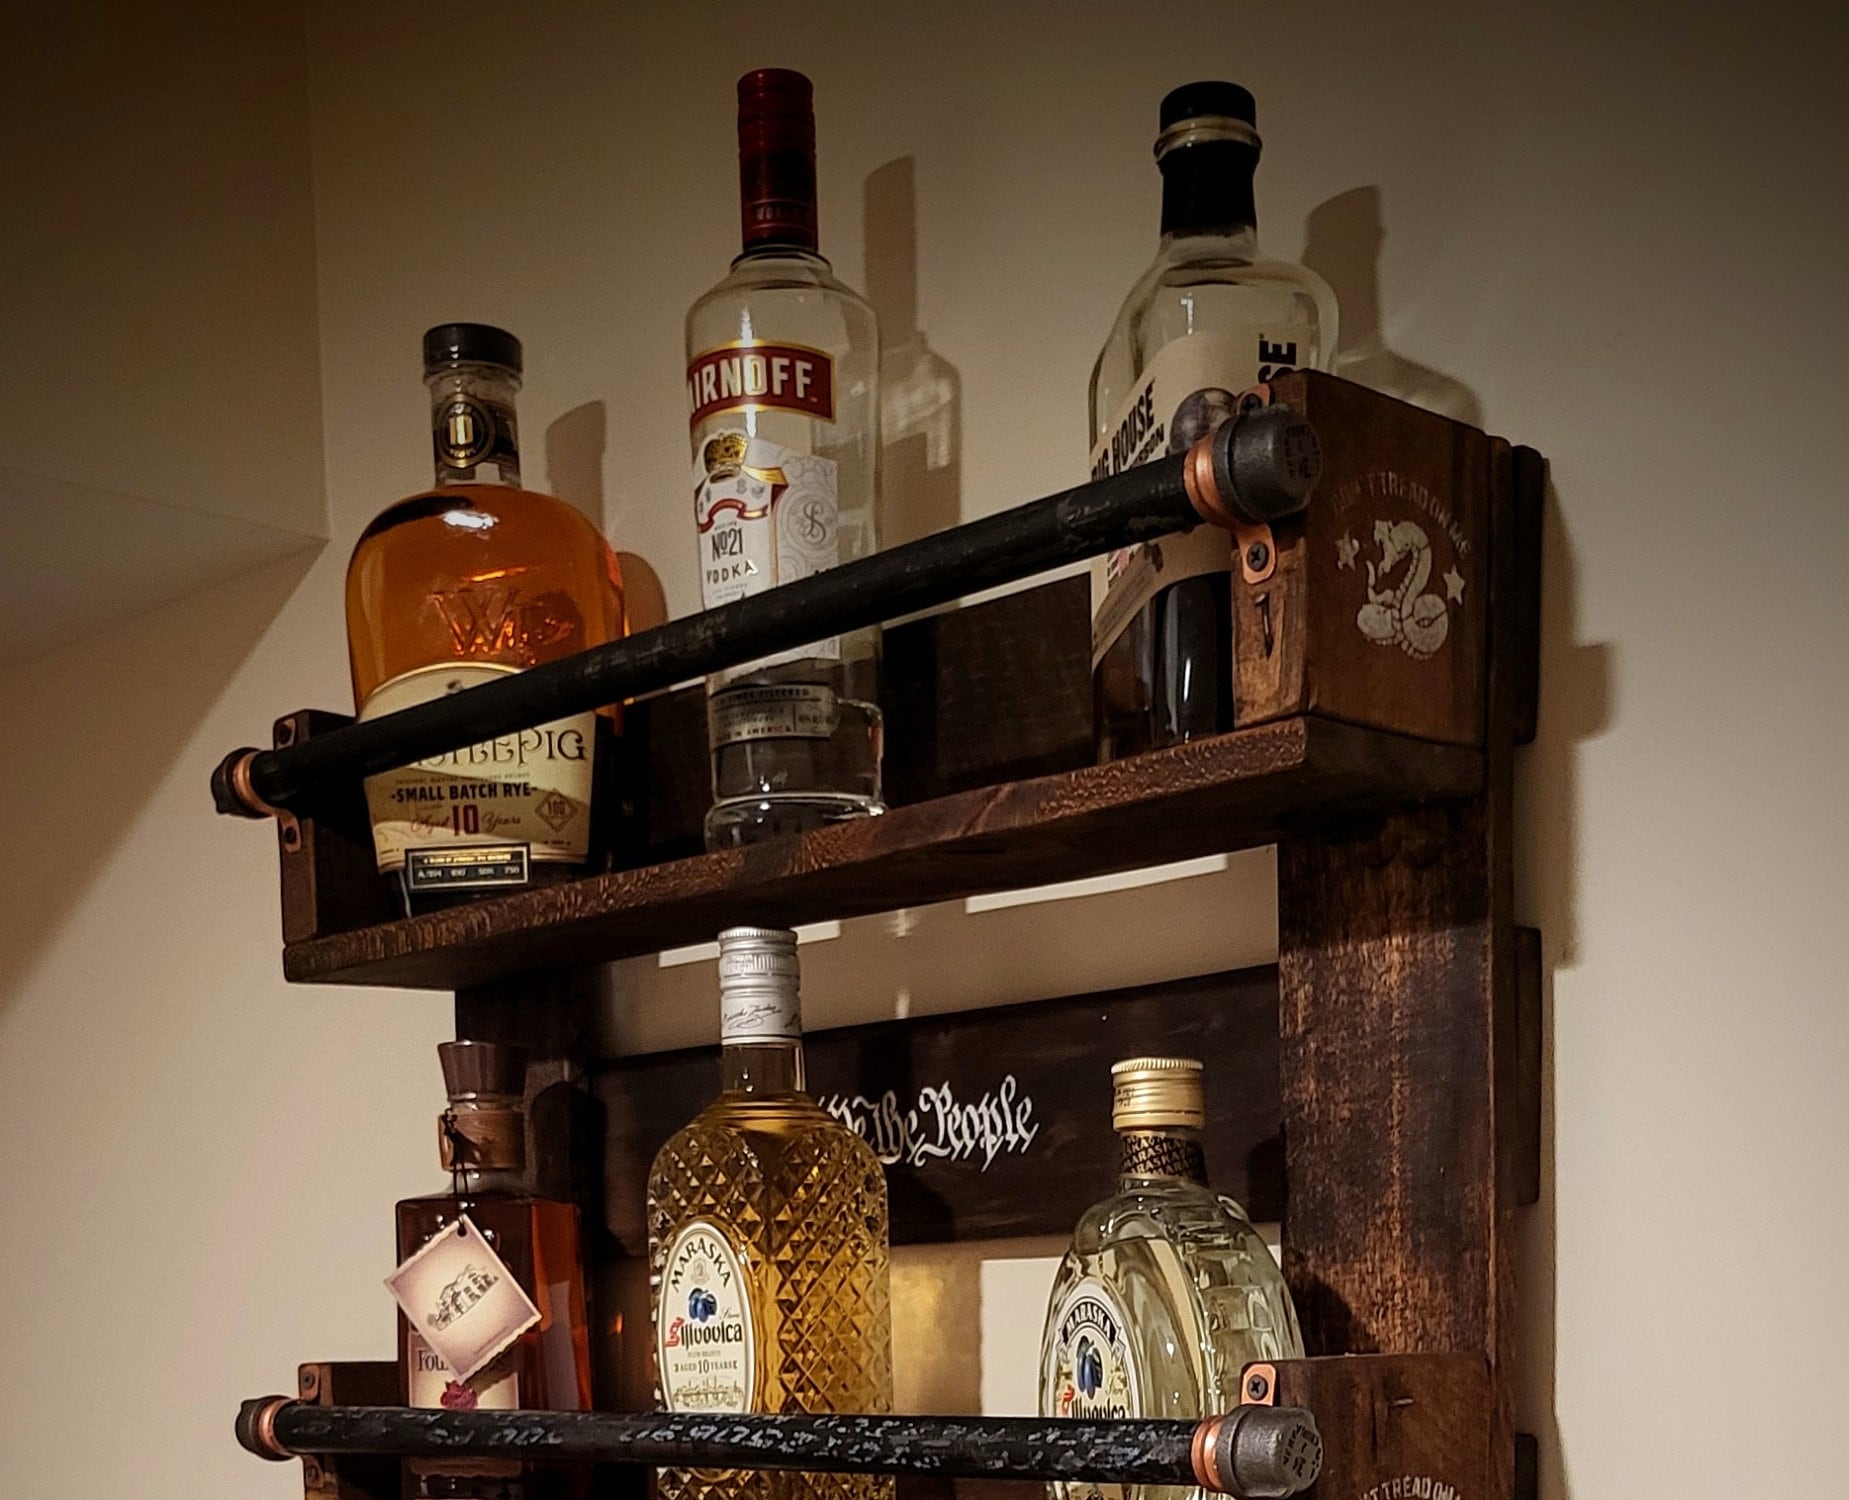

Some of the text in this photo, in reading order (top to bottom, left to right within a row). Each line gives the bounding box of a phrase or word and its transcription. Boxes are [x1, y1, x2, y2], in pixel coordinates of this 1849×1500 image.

[690, 354, 814, 413] IRNOFF
[1112, 380, 1156, 477] HOUSE
[706, 560, 754, 585] VODKA
[396, 781, 532, 804] SMALL BATCH RYE
[452, 803, 480, 837] 10
[918, 1074, 1040, 1173] People
[671, 1237, 732, 1293] MARASKA
[1066, 1302, 1112, 1340] MARASKA
[417, 1349, 450, 1372] FOU
[698, 1359, 710, 1374] 10
[1381, 1475, 1432, 1500] TREAD
